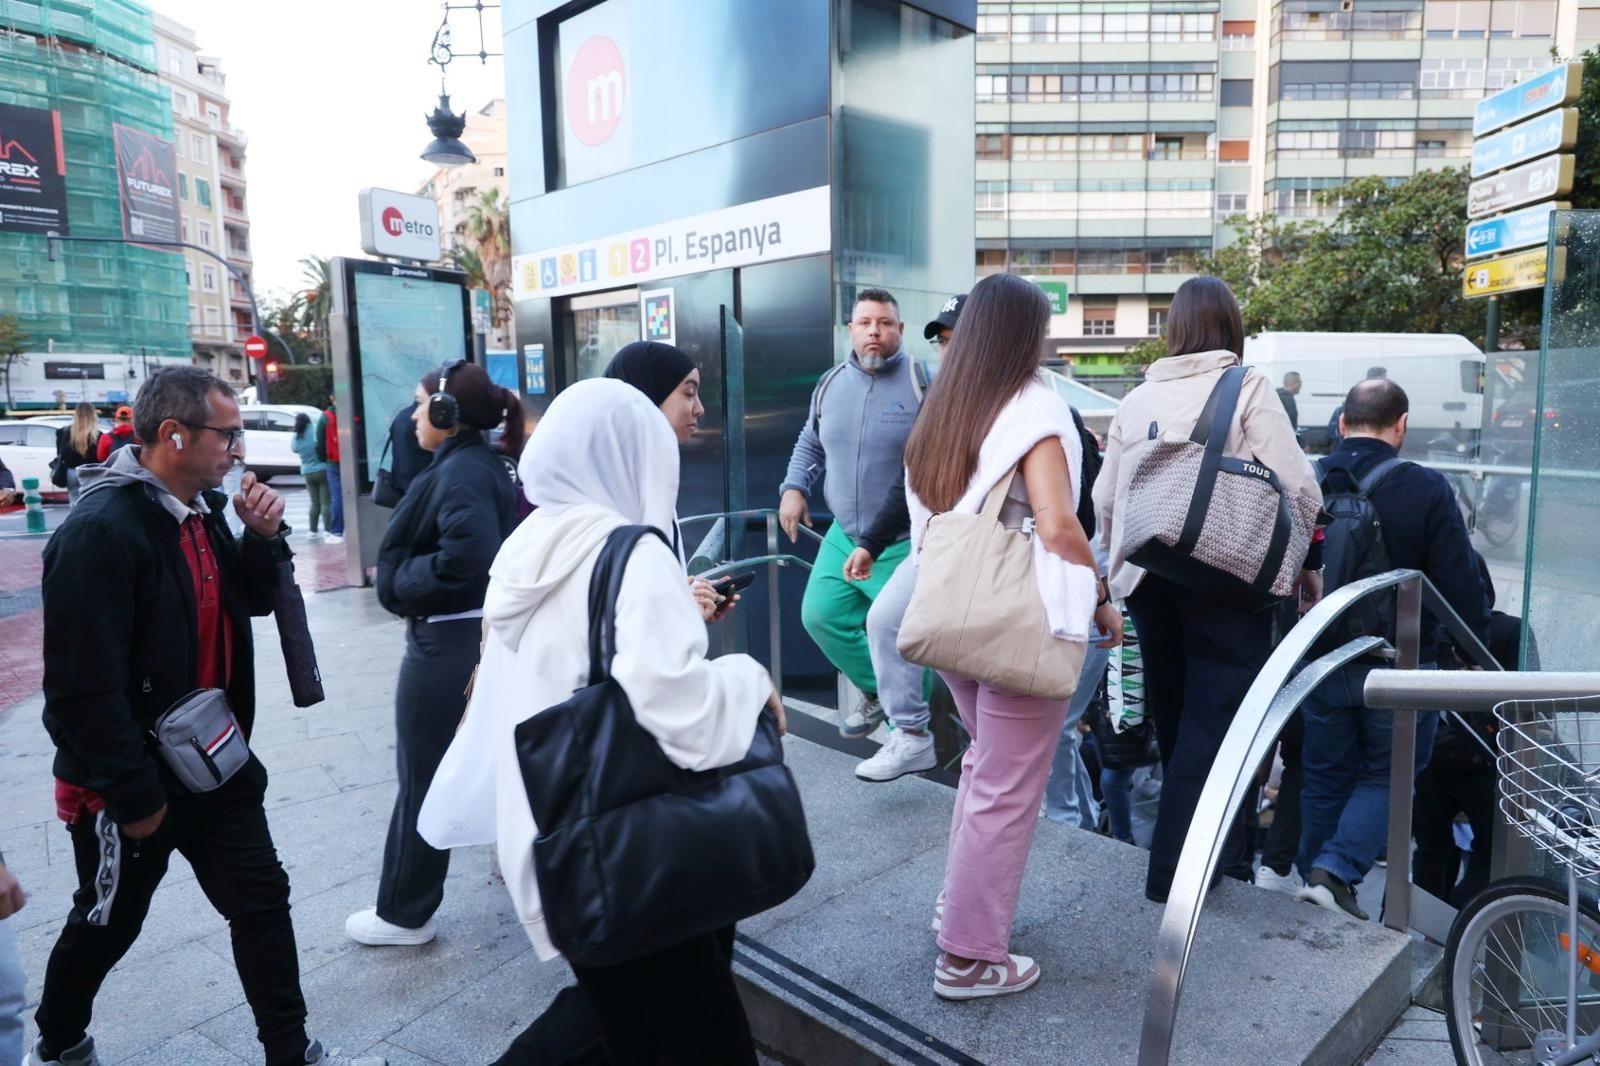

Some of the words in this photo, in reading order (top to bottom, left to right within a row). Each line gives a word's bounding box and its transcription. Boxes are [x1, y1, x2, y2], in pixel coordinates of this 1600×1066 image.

[587, 70, 623, 125] m
[389, 216, 434, 236] metro
[655, 236, 679, 266] Pl.
[686, 221, 782, 264] Espanya
[1243, 463, 1270, 478] TOUS
